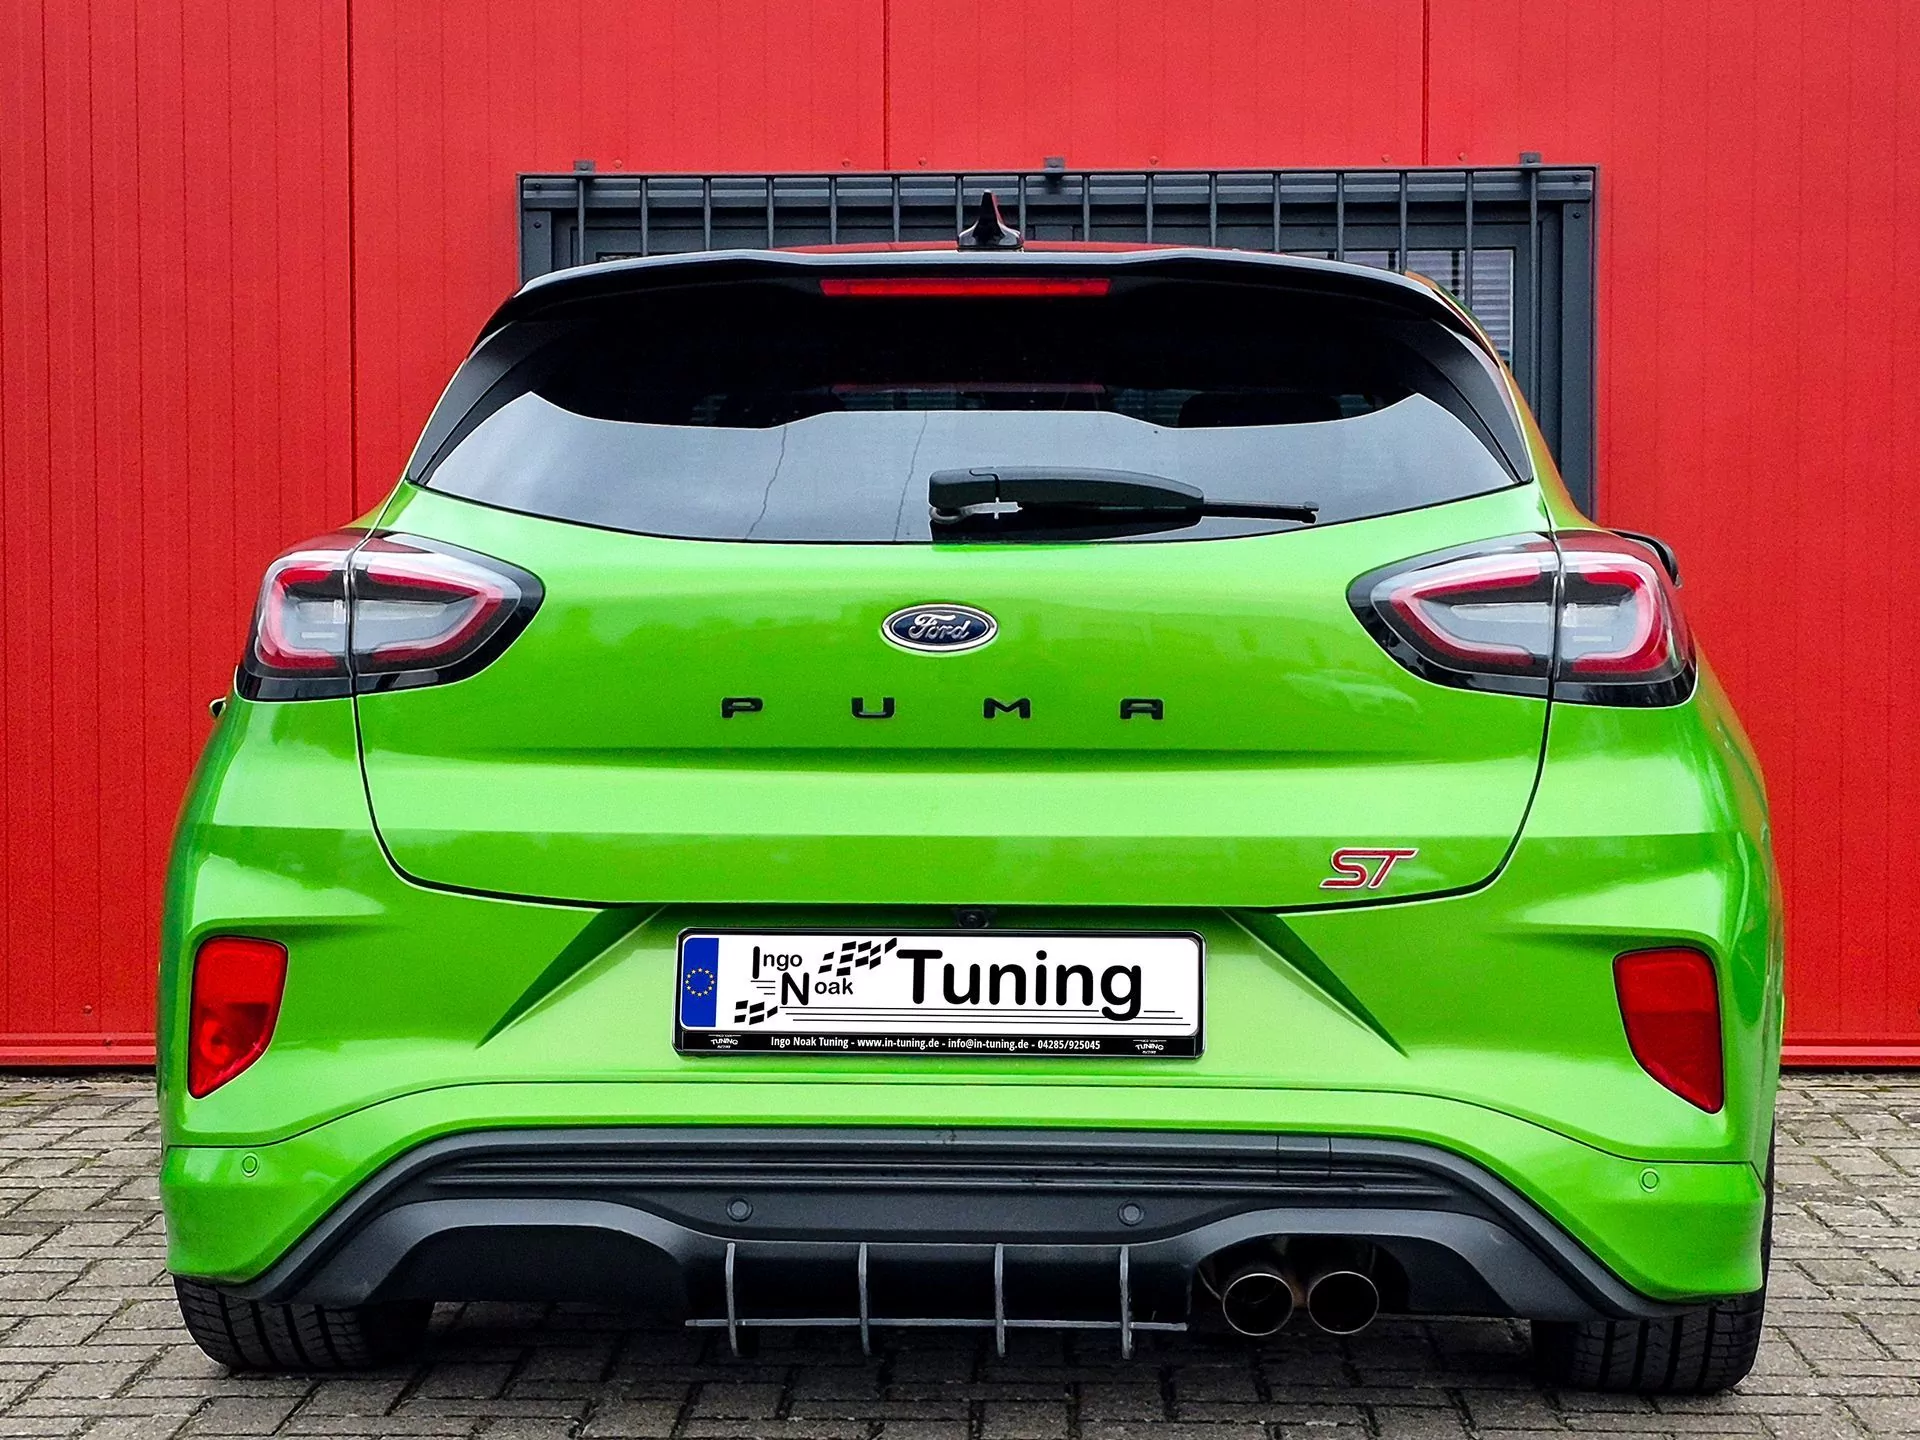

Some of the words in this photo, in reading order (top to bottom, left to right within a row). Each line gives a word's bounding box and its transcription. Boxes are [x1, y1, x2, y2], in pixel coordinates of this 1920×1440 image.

[908, 613, 971, 640] Ford
[720, 697, 1165, 720] PUMA
[1319, 847, 1419, 889] ST
[753, 945, 803, 979] Ingo
[780, 971, 854, 1006] Noak
[896, 948, 1142, 1021] Tuning
[771, 1036, 791, 1049] Ingo
[793, 1036, 817, 1047] Noak
[818, 1036, 849, 1049] Tuning
[857, 1037, 940, 1050] www.in-tuning.de
[948, 1037, 1029, 1051] info@in-tuning.de
[1037, 1039, 1101, 1051] 04285/925045
